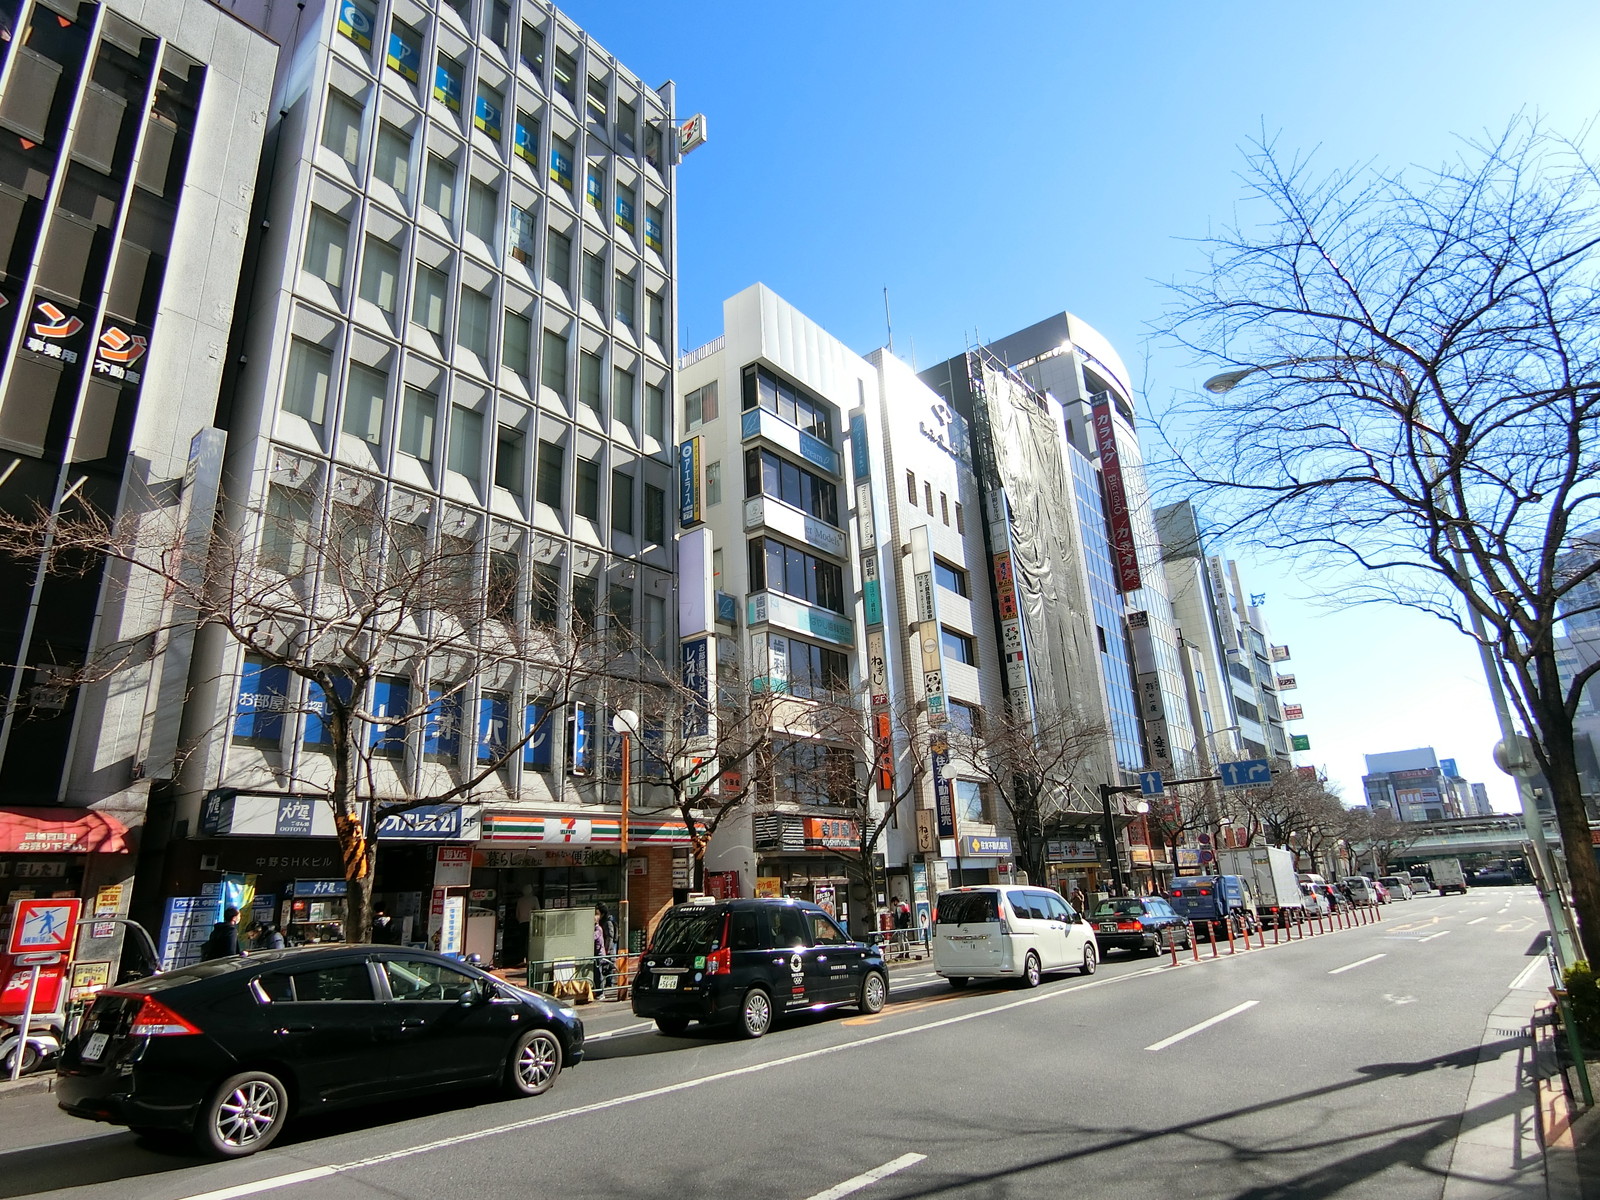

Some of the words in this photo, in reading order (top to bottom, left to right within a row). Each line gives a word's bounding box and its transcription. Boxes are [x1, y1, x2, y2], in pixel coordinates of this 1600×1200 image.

[1097, 413, 1117, 464] カラオケ
[756, 596, 766, 620] 歯科
[774, 639, 787, 675] 歯科
[870, 656, 884, 686] ねぎし
[874, 695, 887, 704] 2F
[280, 802, 311, 822] 大戸屋
[463, 818, 477, 827] 2F
[256, 856, 332, 868] 中野SHKビル
[314, 881, 336, 893] 大戸屋
